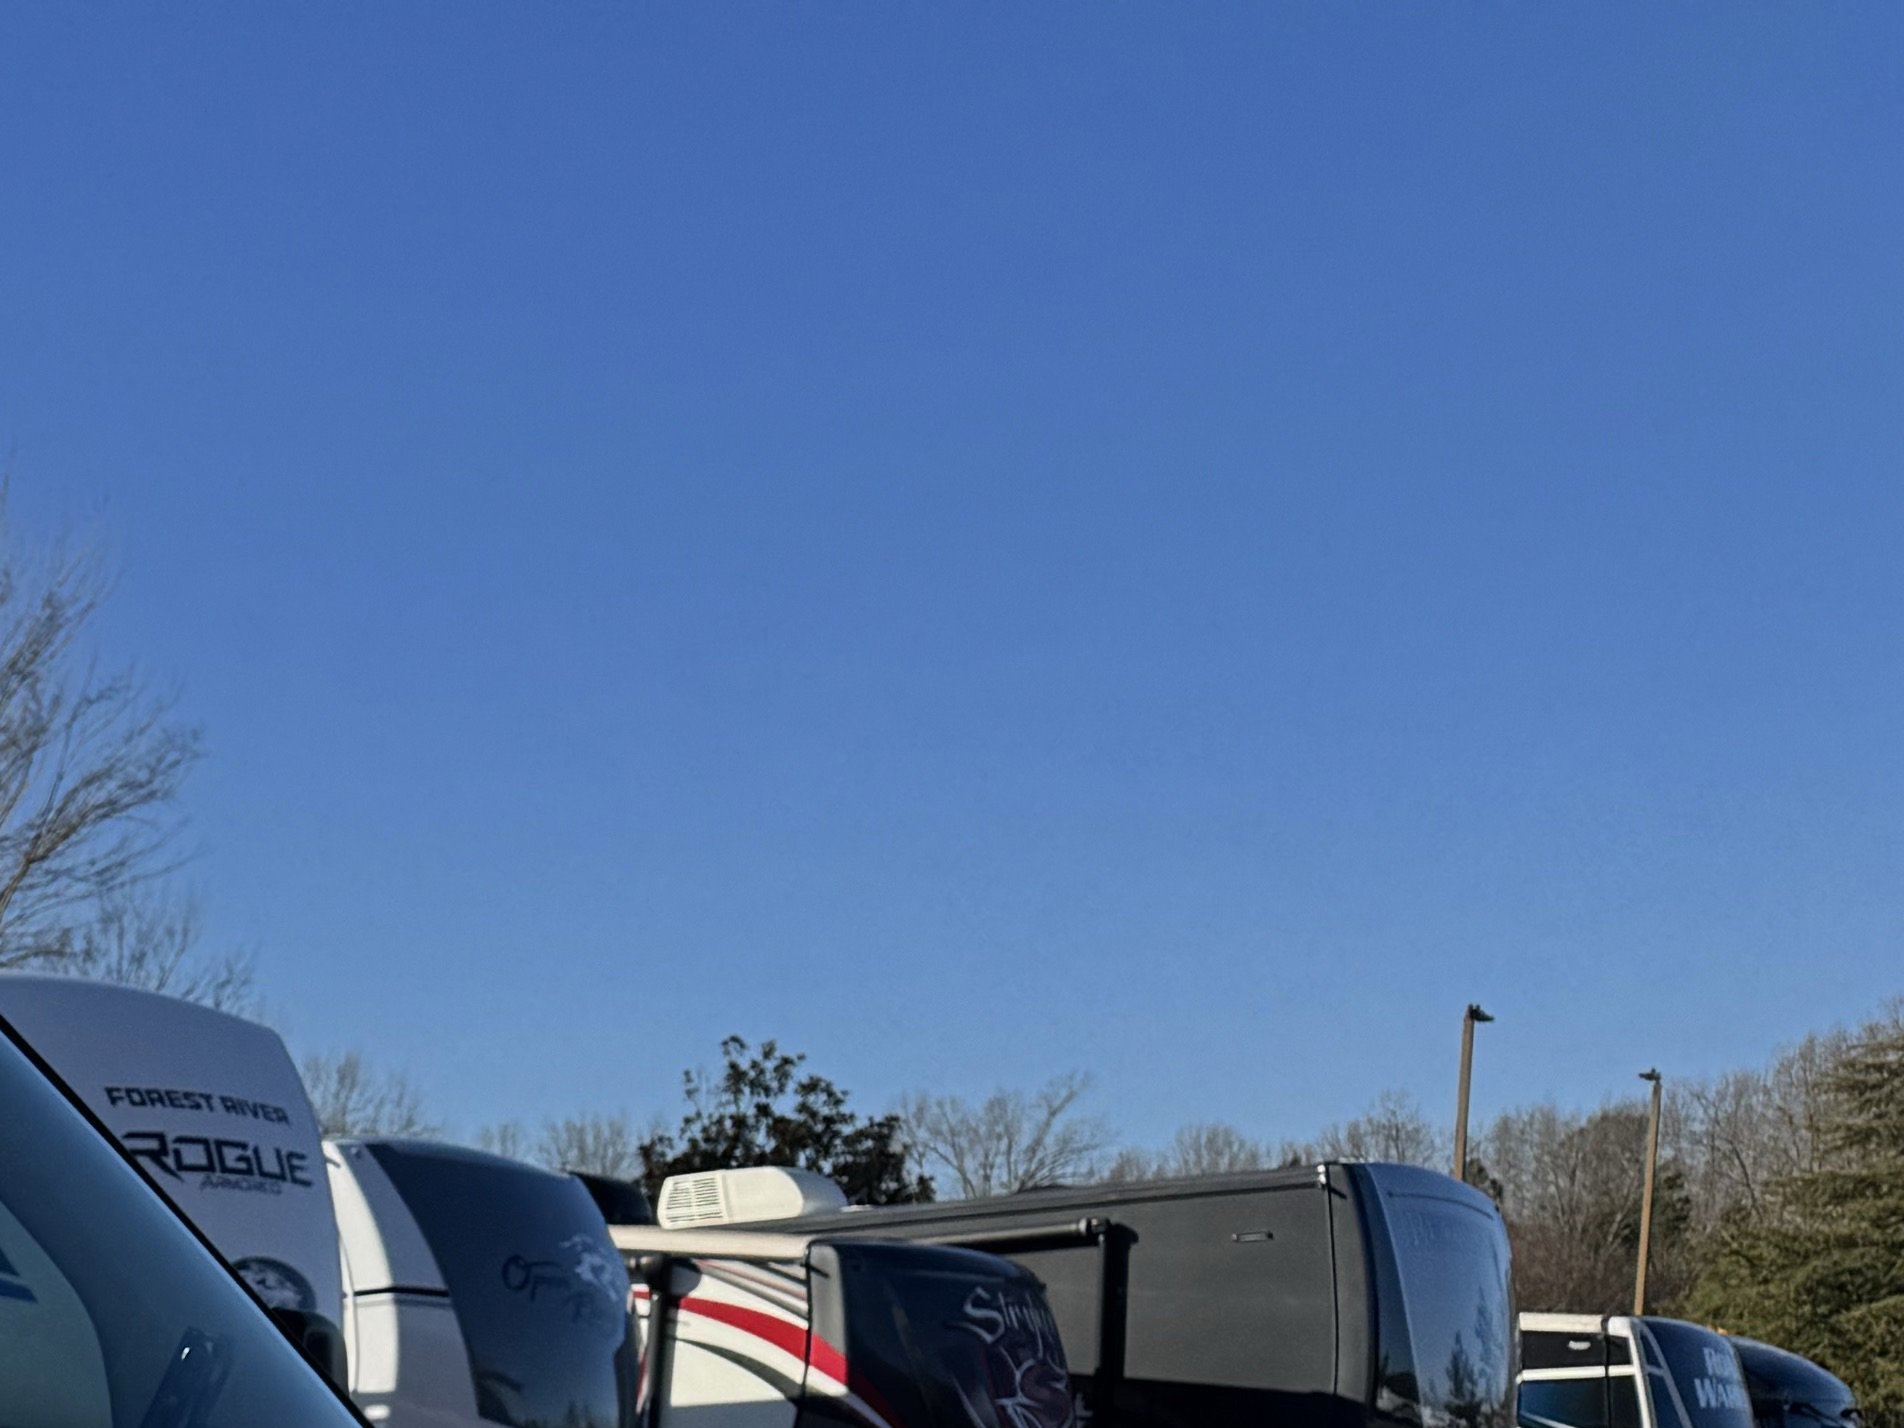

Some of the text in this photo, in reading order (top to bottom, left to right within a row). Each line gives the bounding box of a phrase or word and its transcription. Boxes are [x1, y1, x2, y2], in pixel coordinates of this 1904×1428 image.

[104, 1086, 291, 1126] FOREST RIVER
[121, 1131, 313, 1188] ROGUE
